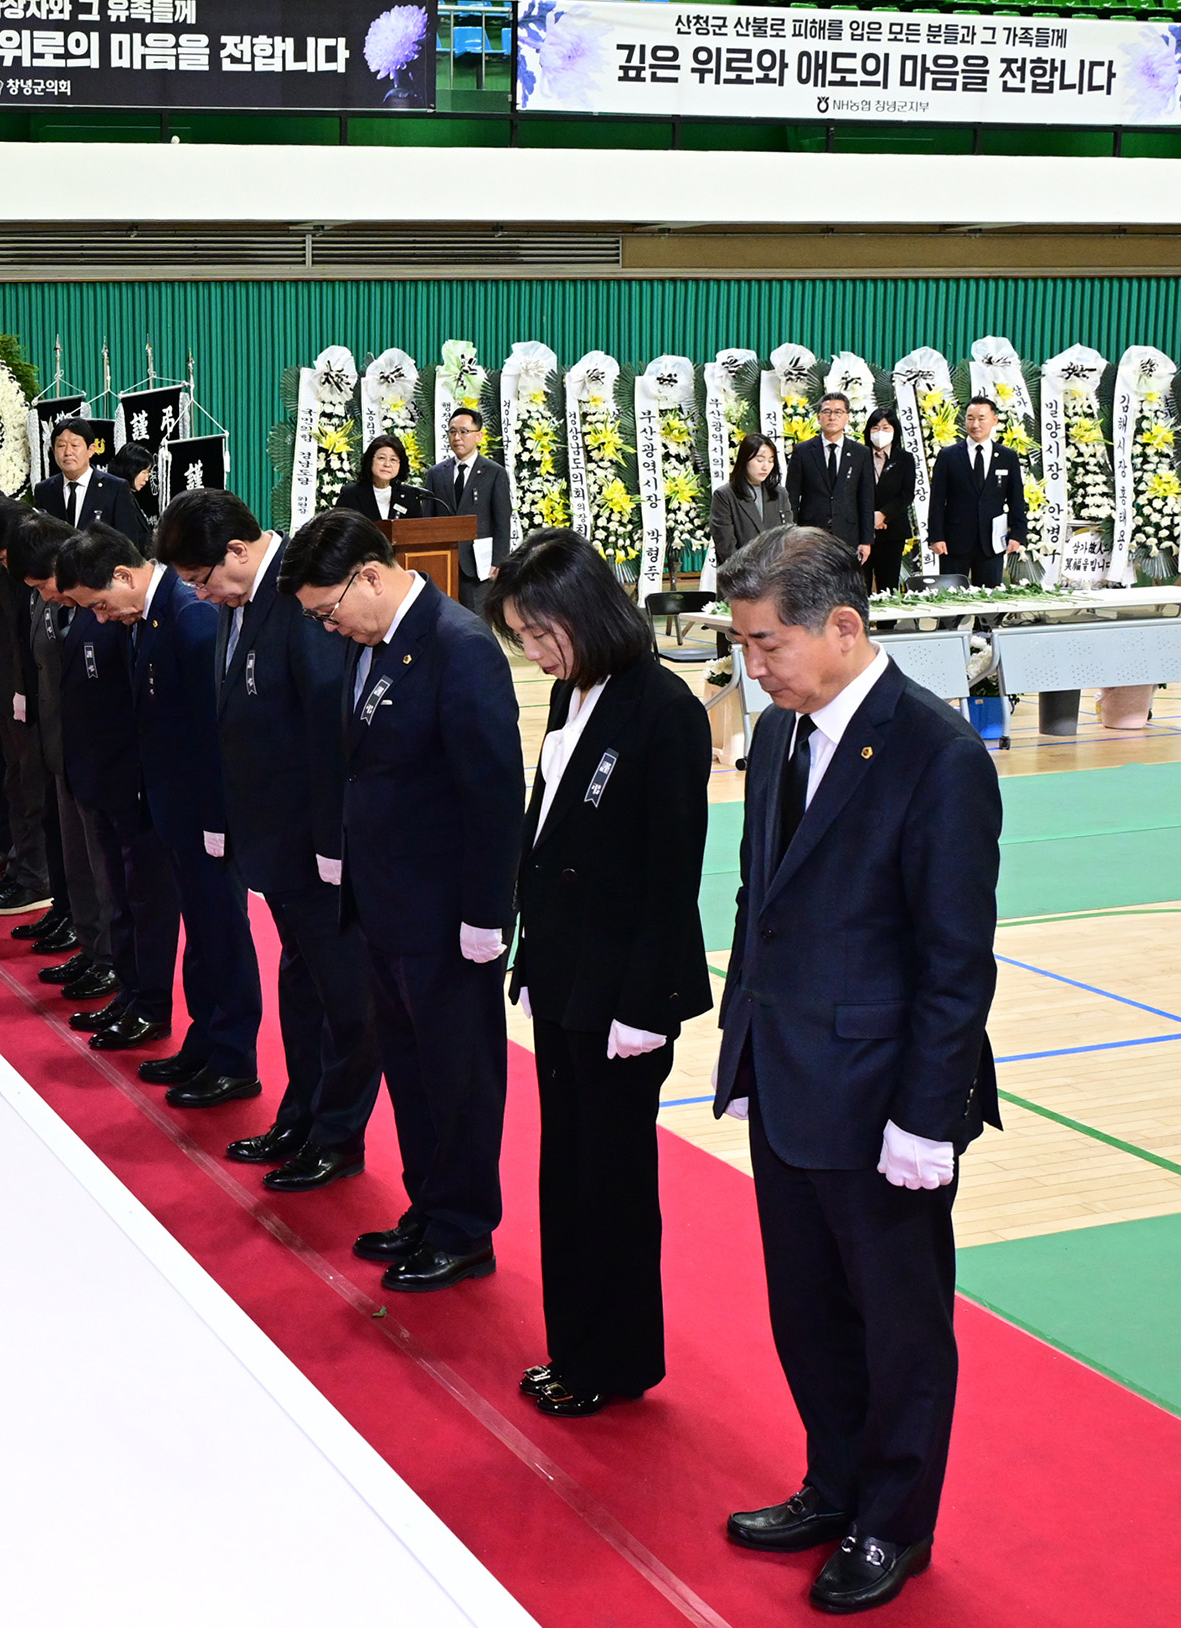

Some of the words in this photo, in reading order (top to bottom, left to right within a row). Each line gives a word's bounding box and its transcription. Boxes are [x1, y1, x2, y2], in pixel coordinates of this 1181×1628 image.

[77, 0, 100, 21] 그
[107, 0, 196, 24] 유족들께
[675, 15, 728, 36] 산청군
[733, 17, 786, 38] 산불로
[791, 19, 843, 41] 피해를
[849, 20, 883, 42] 입은
[887, 22, 921, 43] 모든
[926, 23, 977, 45] 분들과
[980, 27, 997, 44] 그
[1002, 27, 1068, 48] 가족들께
[110, 32, 210, 71] 마음을
[220, 35, 349, 73] 전합니다
[616, 44, 681, 83] 깊은
[690, 46, 789, 86] 위로와
[797, 50, 890, 90] 애도의
[899, 53, 990, 92] 마음을
[999, 57, 1117, 95] 전합니다
[6, 78, 72, 97] 창녕군의회
[833, 99, 871, 112] NH농협
[875, 100, 929, 113] 창녕군지부
[569, 411, 585, 501] 경상남도의회
[638, 410, 661, 509] 부산광역시장
[709, 398, 724, 481] 부산광역시의회
[1045, 399, 1063, 481] 밀양시장
[1117, 395, 1131, 478] 김해시장
[644, 528, 662, 581] 박형준
